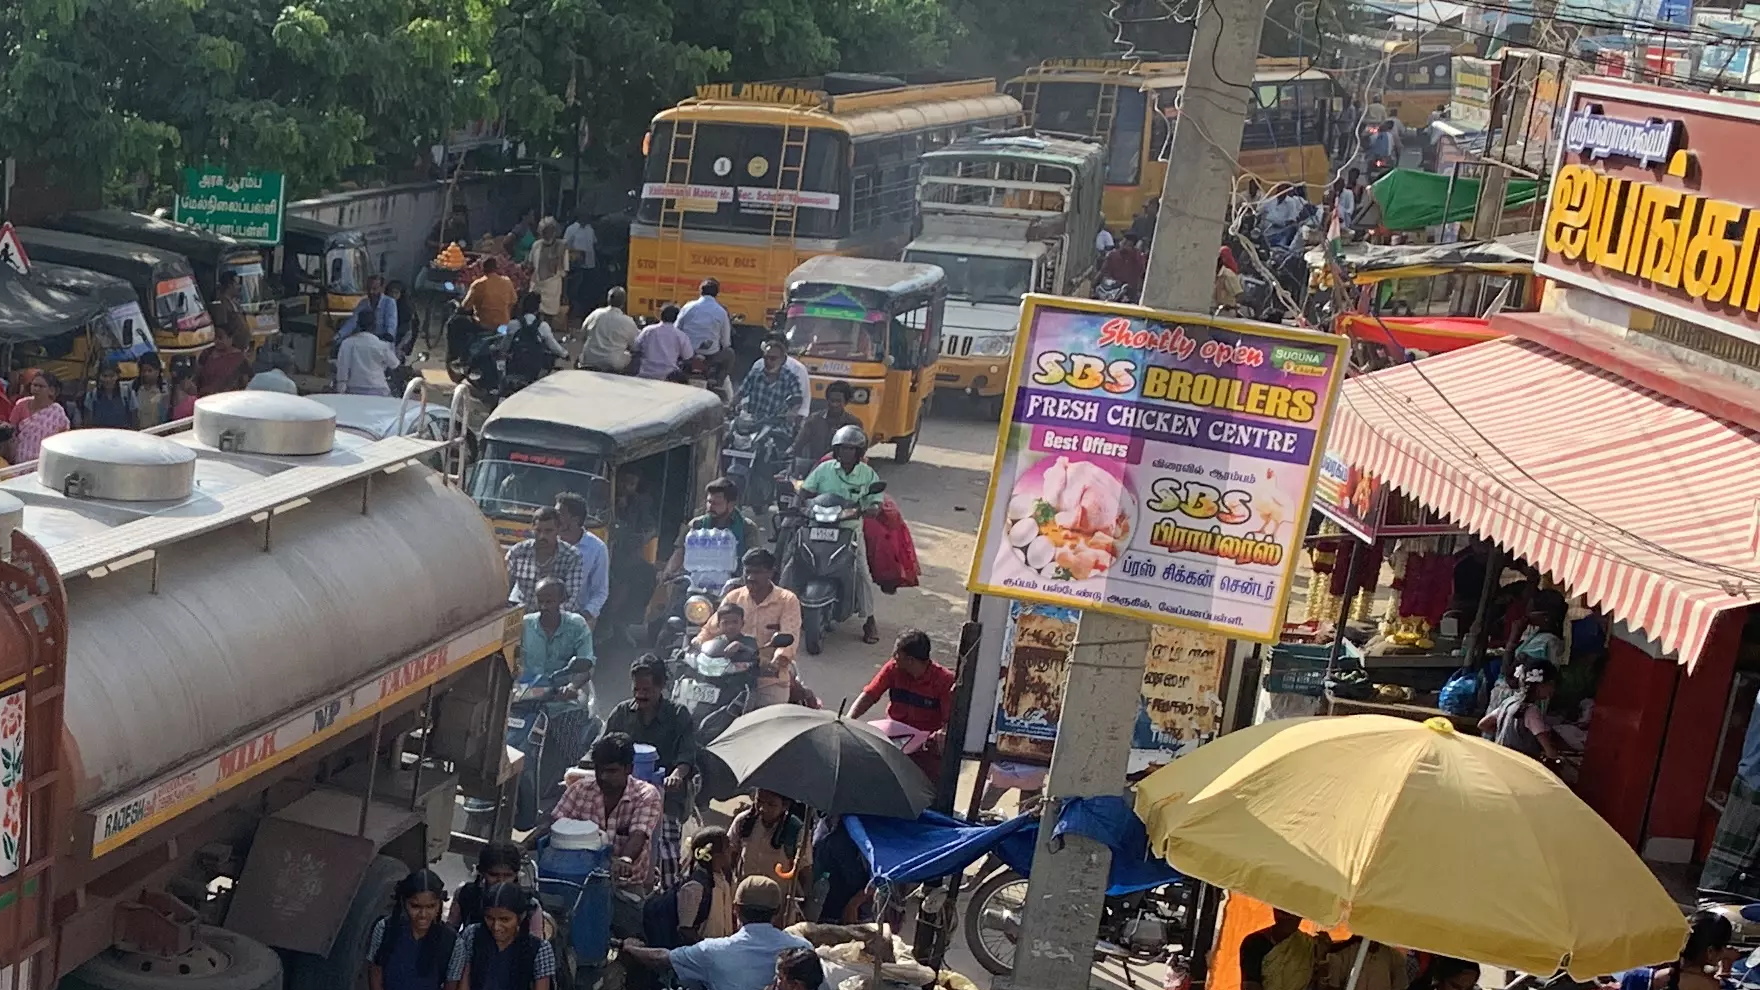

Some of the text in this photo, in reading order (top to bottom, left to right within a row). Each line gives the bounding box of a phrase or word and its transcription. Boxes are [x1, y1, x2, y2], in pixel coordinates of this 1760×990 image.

[1097, 317, 1264, 367] Shortly open
[1275, 348, 1320, 364] SUGUNA
[1032, 351, 1318, 423] SBS BROILERS
[1026, 394, 1298, 454] FRESH CHICKEN CENTRE
[1043, 429, 1129, 459] Best Offers
[1146, 477, 1252, 525] SBS
[104, 798, 145, 839] RAJESH
[216, 729, 277, 782] MILK
